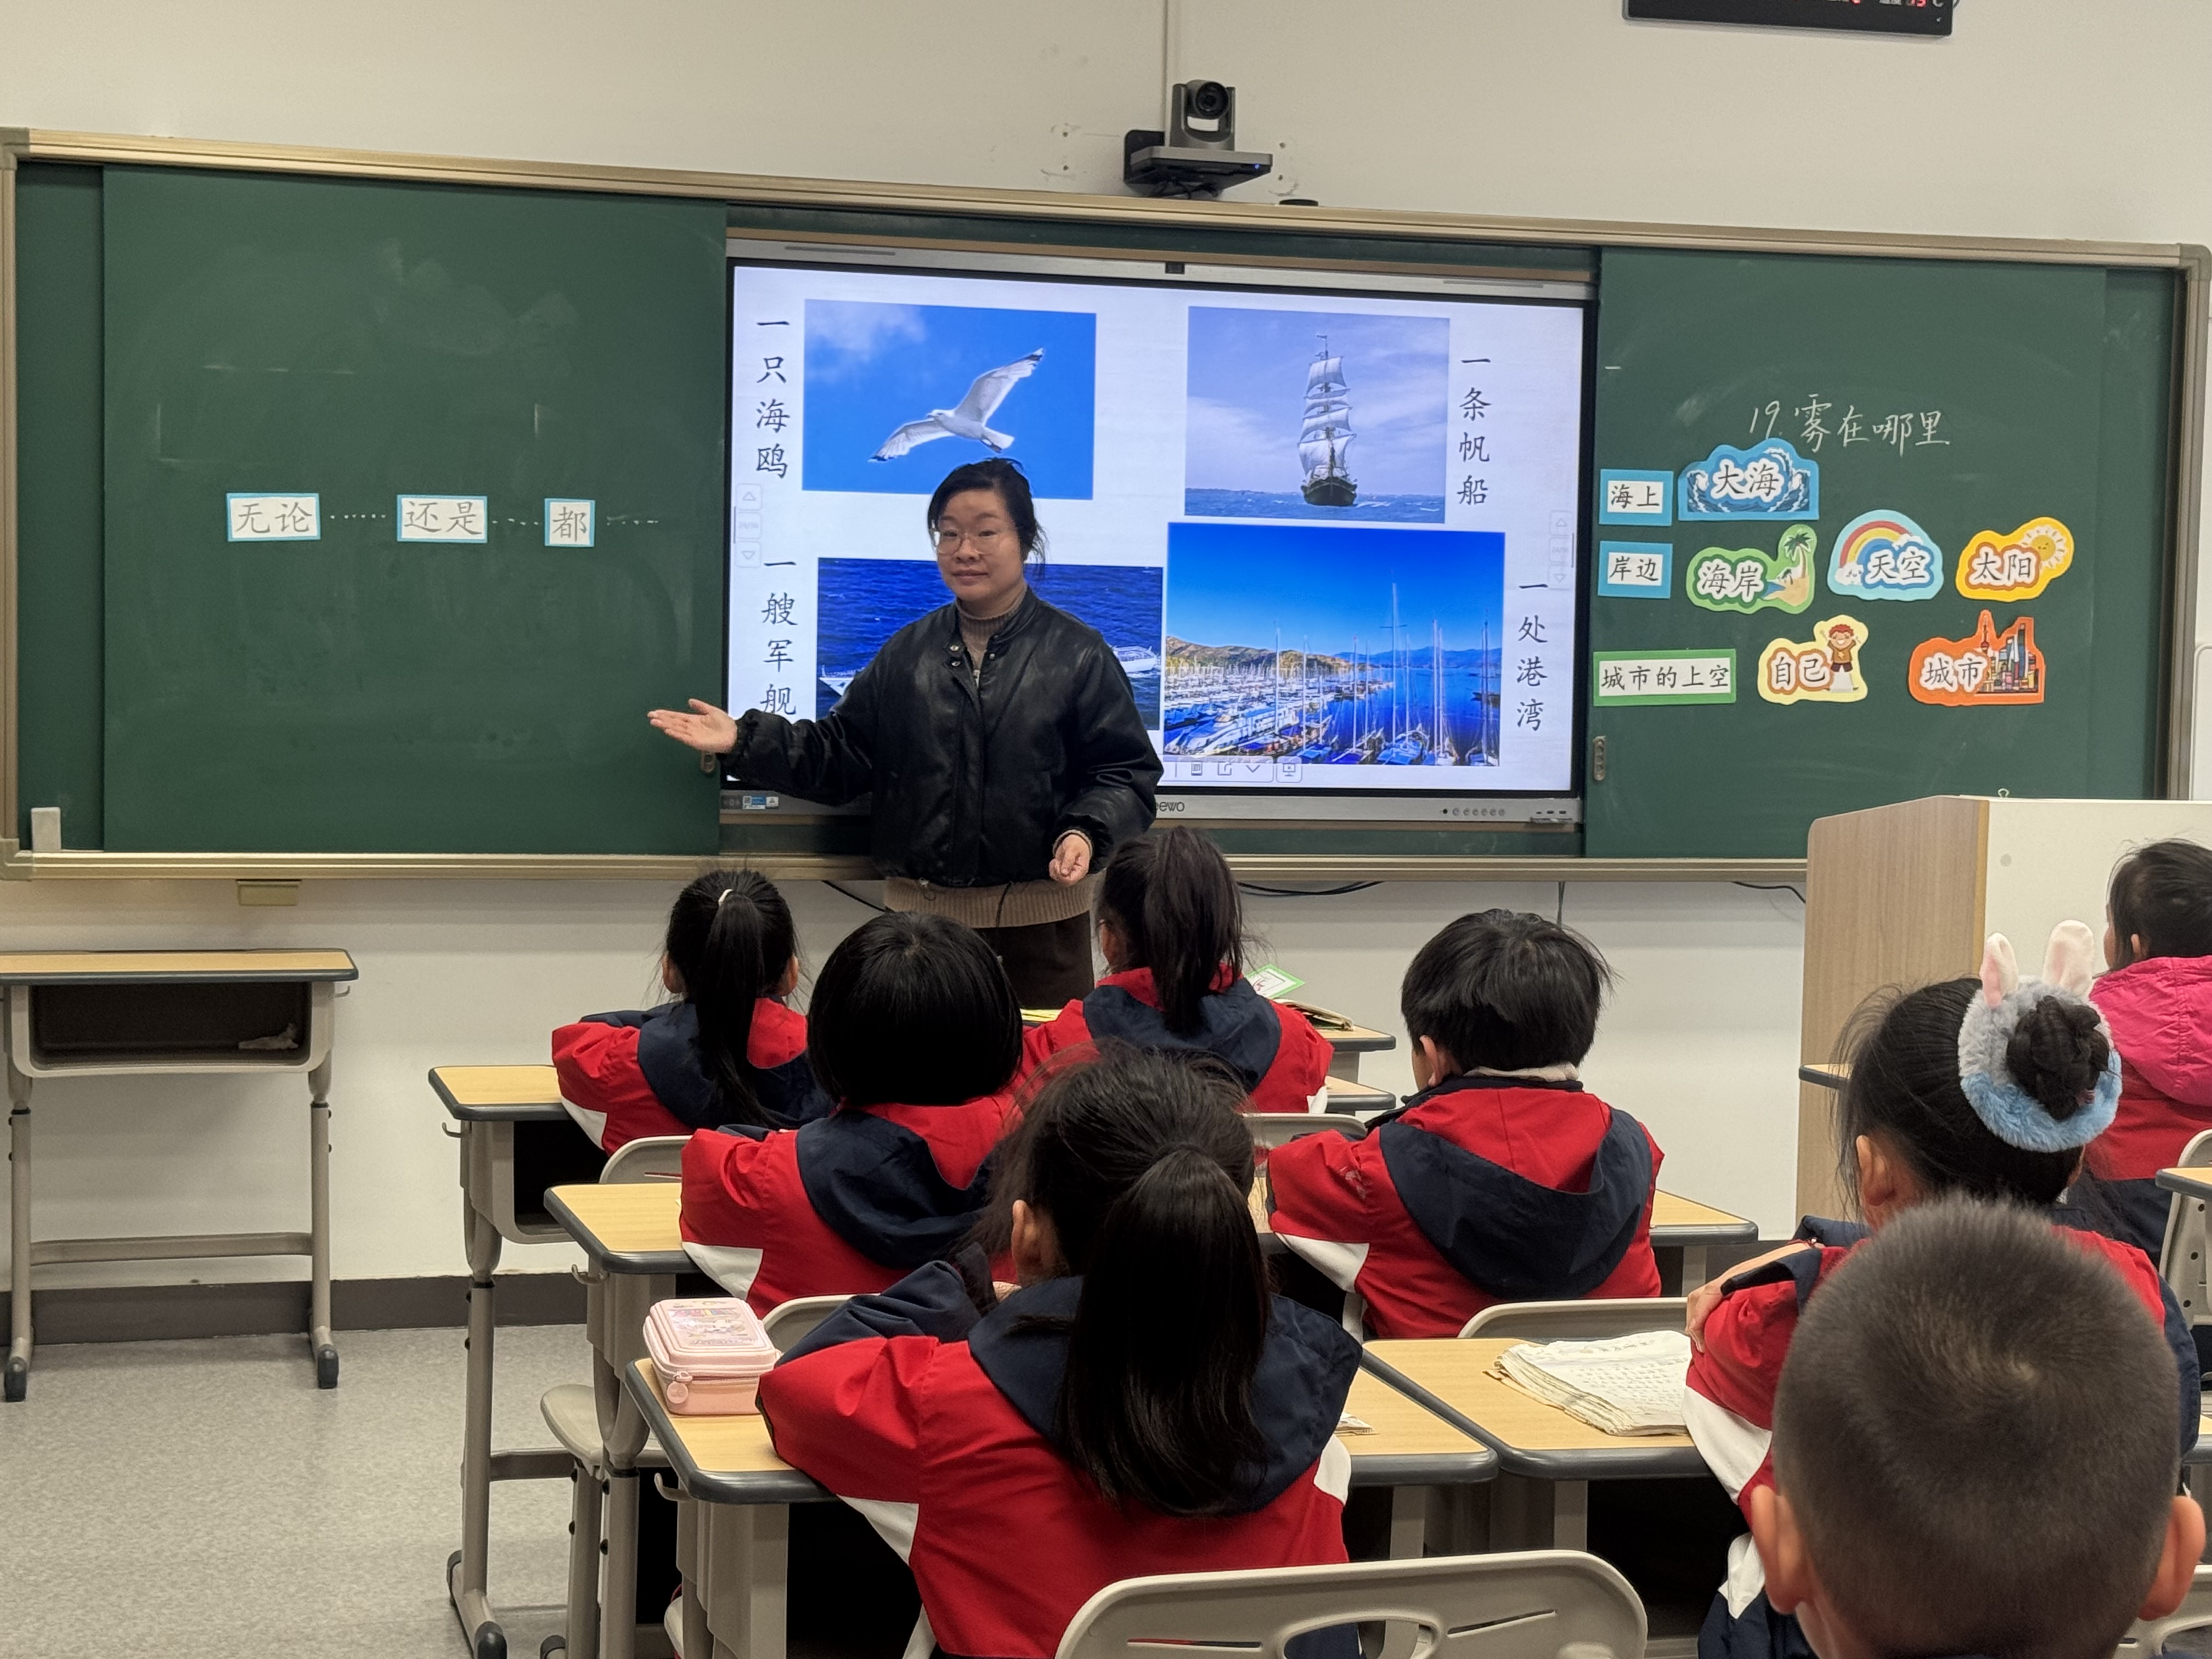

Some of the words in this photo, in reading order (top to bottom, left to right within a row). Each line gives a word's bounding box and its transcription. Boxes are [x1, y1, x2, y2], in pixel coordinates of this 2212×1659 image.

[756, 321, 790, 478] 一只海鸥
[1457, 358, 1492, 505] 一条帆船
[1610, 483, 1660, 509] 海上
[1716, 464, 1779, 497] 大海
[235, 501, 313, 534] 无论
[404, 501, 482, 535] 还是
[552, 506, 588, 542] 都
[1609, 555, 1659, 582] 岸边
[1869, 550, 1927, 580] 天空
[1973, 551, 2033, 581] 太阳
[1701, 563, 1760, 599] 海岸
[759, 561, 798, 715] 一艘军舰
[1516, 583, 1549, 731] 一处港湾
[1775, 656, 1825, 685] 自己
[1924, 657, 1983, 687] 城市
[1600, 664, 1730, 691] 城市的上空
